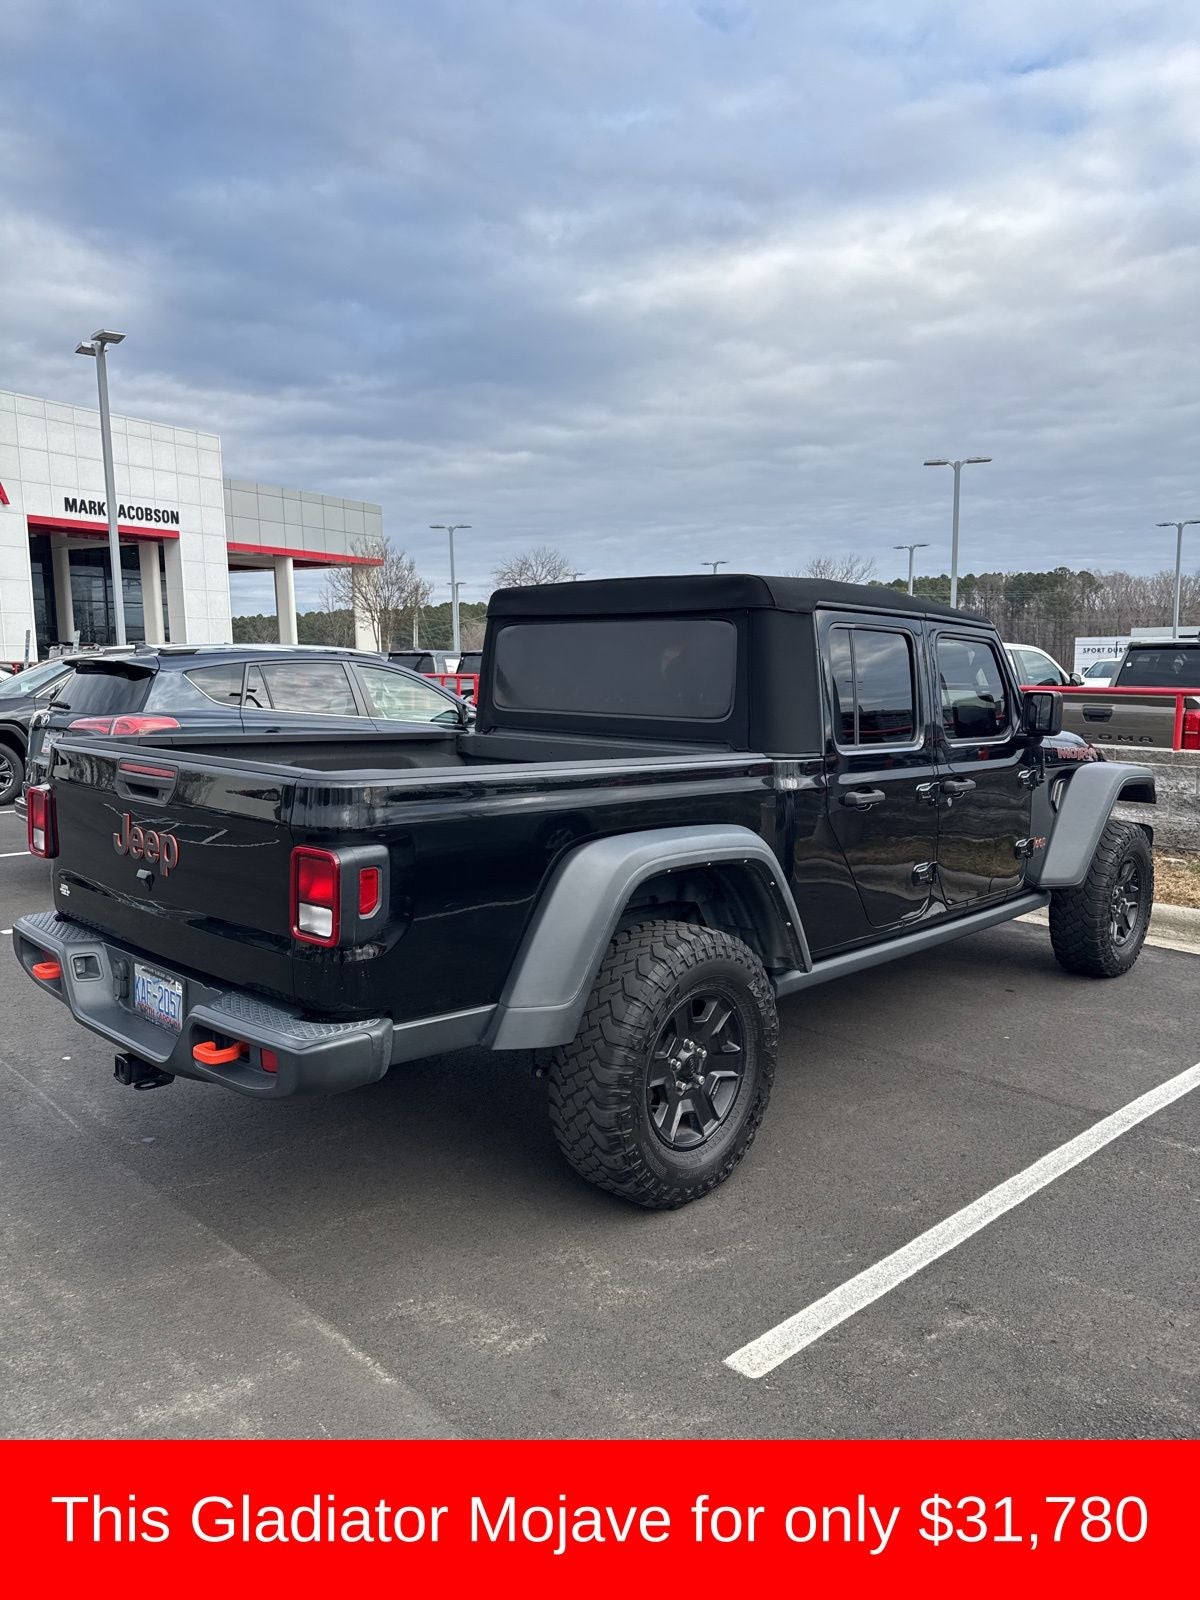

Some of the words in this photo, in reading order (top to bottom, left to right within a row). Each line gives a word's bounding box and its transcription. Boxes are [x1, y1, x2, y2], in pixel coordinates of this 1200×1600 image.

[64, 496, 106, 517] MARK
[117, 503, 180, 525] ACOBSON
[112, 813, 178, 877] Jeep
[135, 975, 181, 1021] KAF-2057
